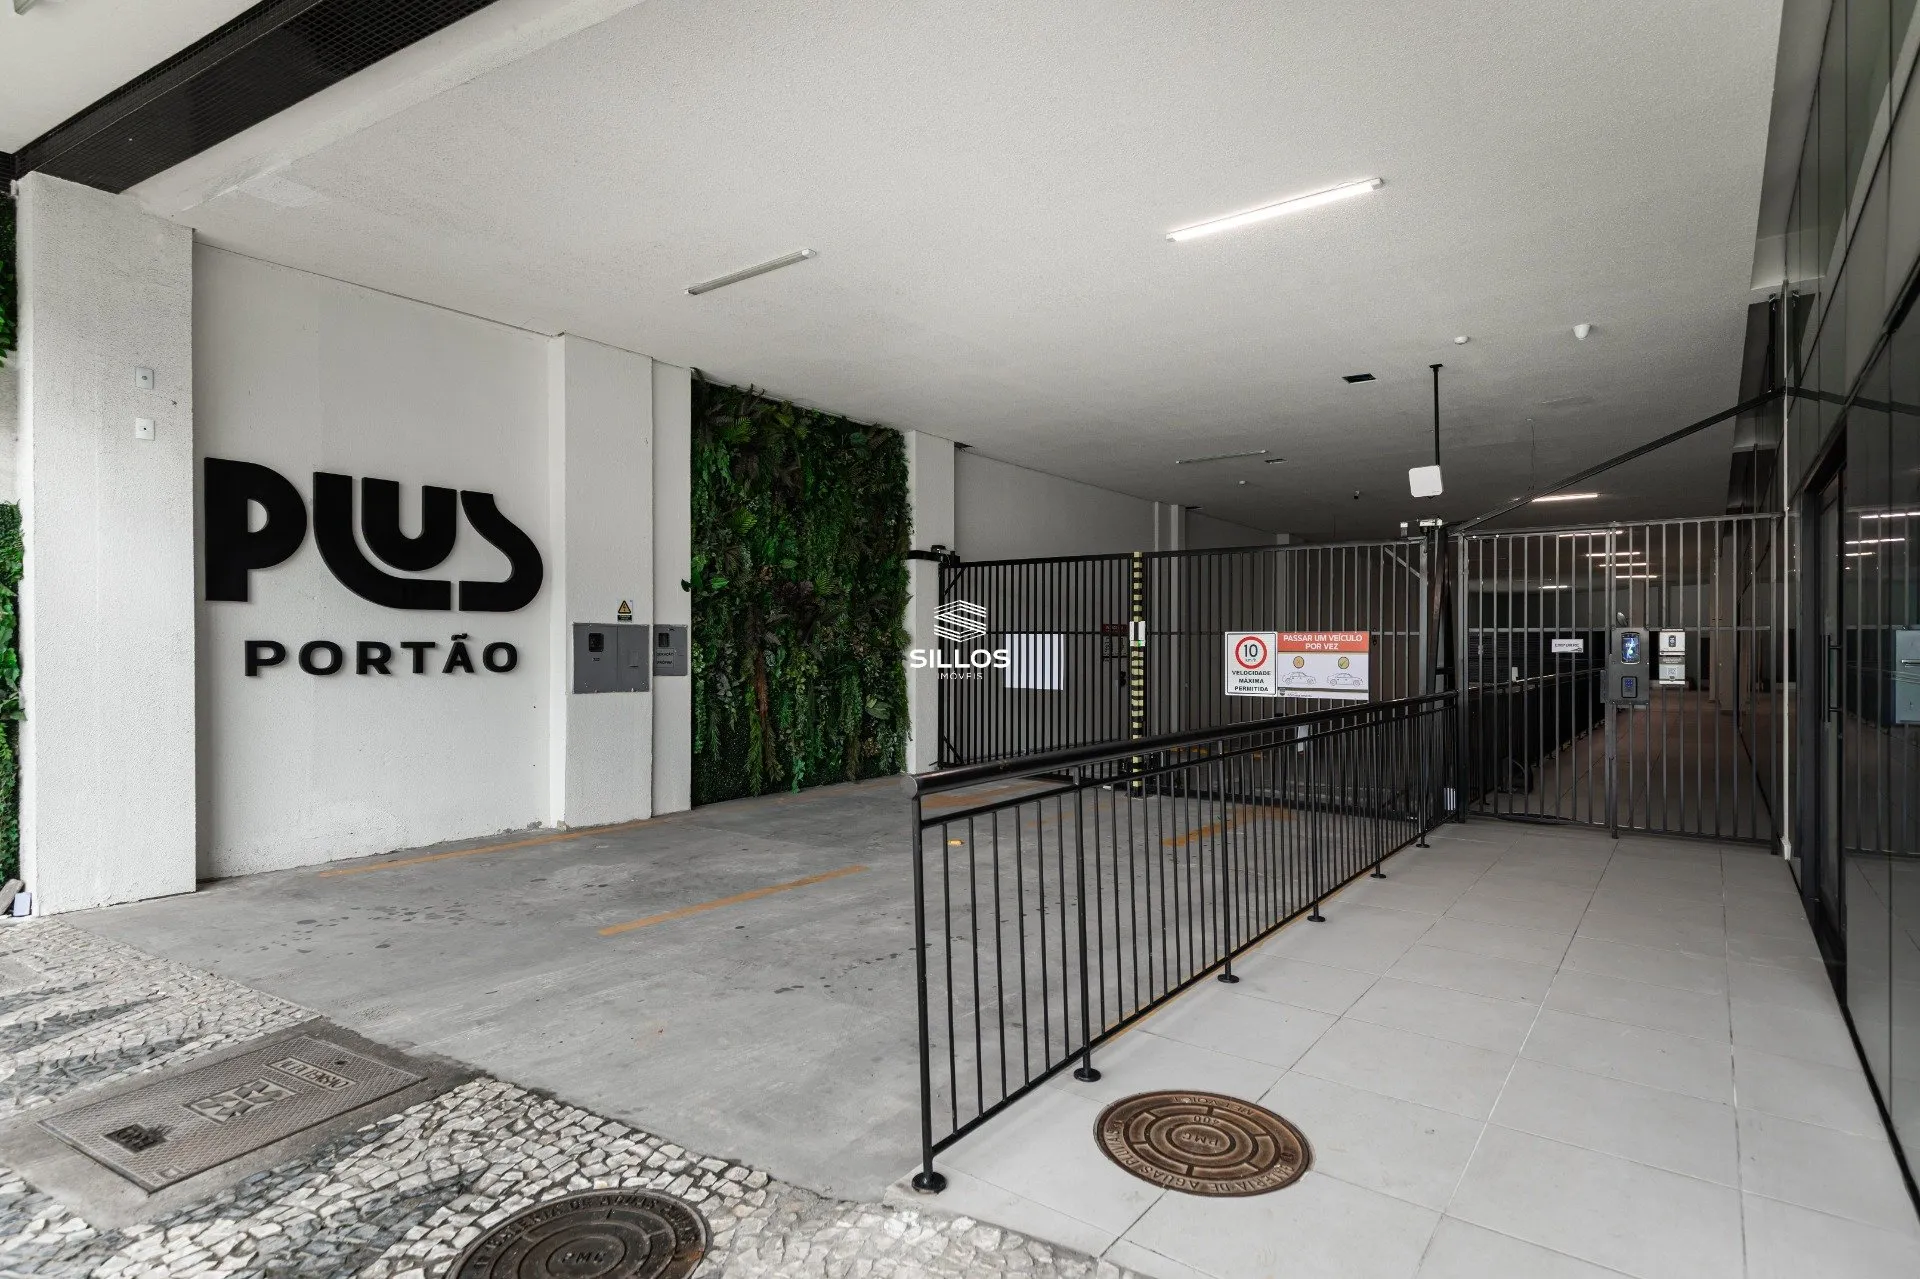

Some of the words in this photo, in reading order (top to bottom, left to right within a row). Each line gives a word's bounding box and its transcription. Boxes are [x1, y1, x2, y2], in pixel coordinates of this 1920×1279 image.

[204, 457, 543, 612] PLUS
[1283, 634, 1312, 642] PASSAR
[1314, 634, 1327, 642] UM
[1329, 633, 1363, 642] VEÍCULO
[1243, 643, 1259, 658] 10
[1305, 642, 1322, 650] POR
[1323, 642, 1339, 650] VEZ
[244, 633, 518, 677] PORTÃO
[1193, 1115, 1220, 1126] 400
[1182, 1132, 1219, 1147] PMC
[1210, 1182, 1230, 1192] DE
